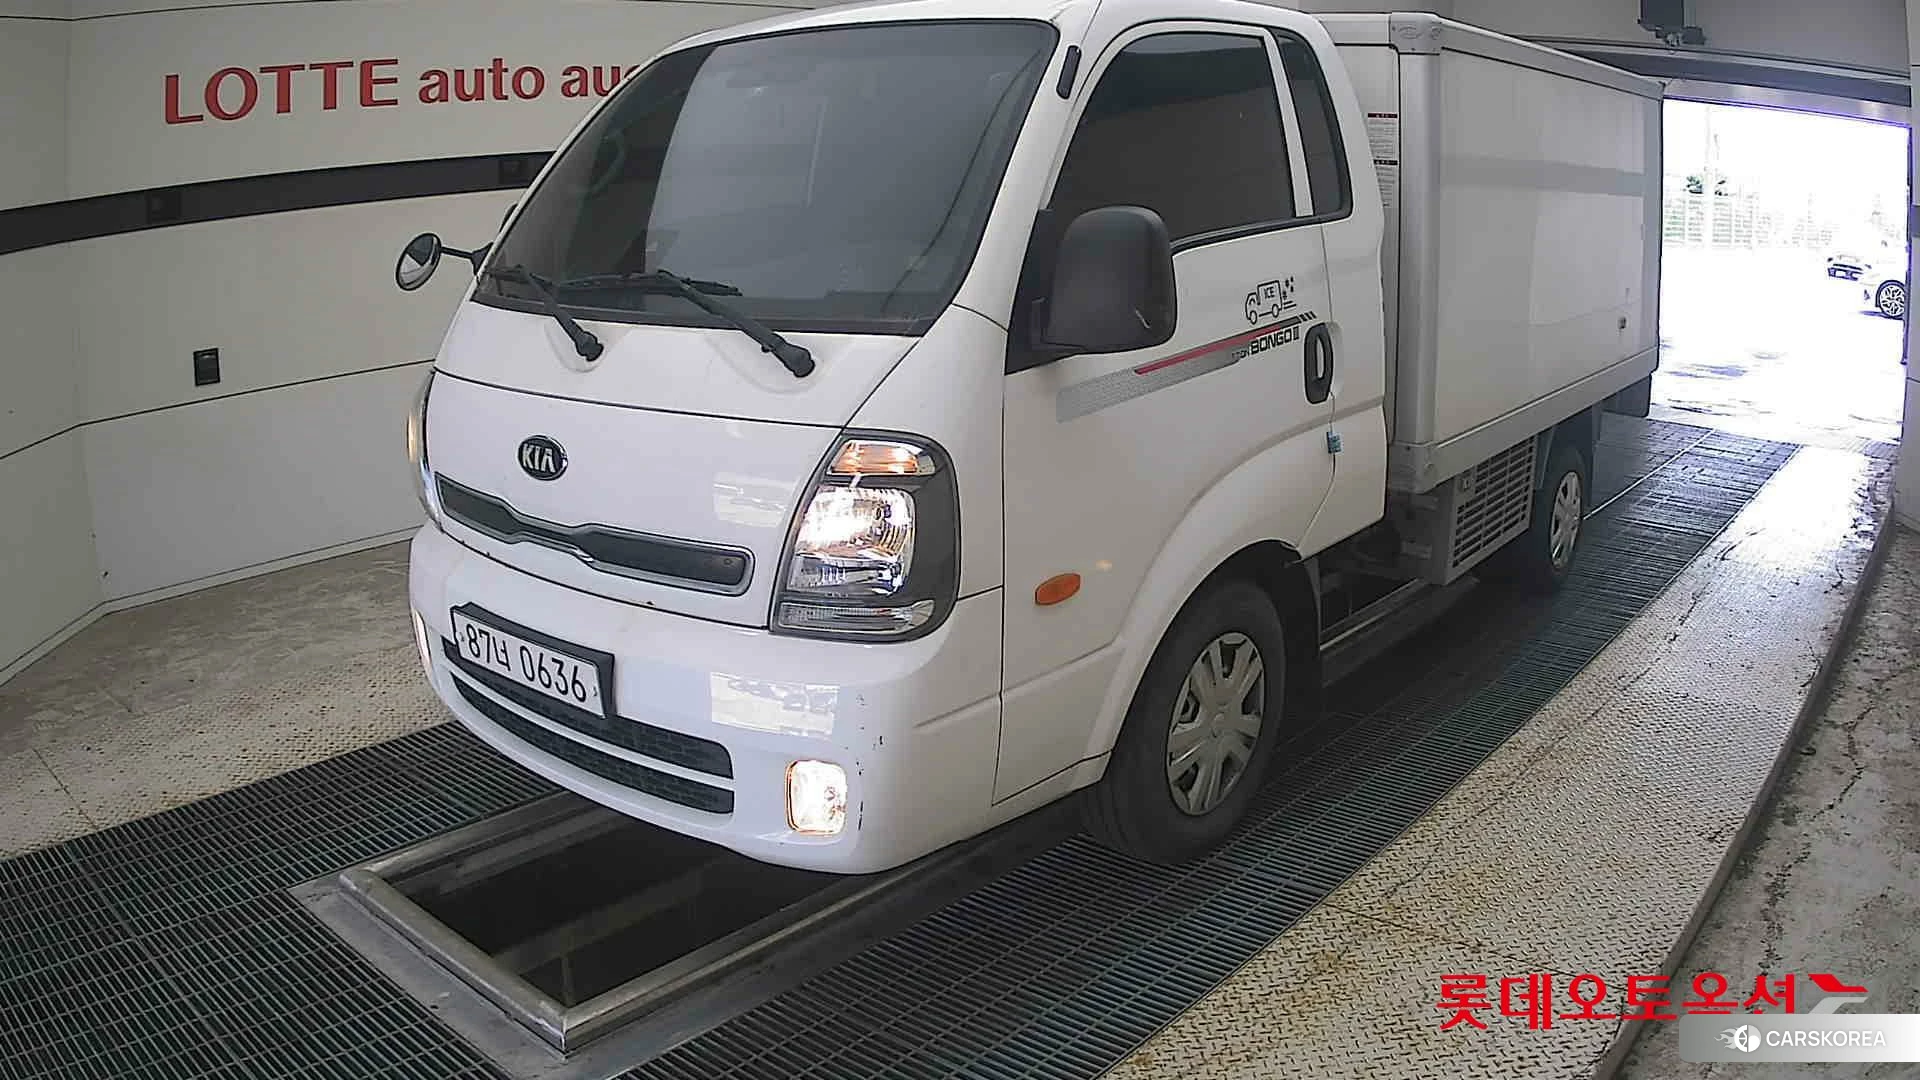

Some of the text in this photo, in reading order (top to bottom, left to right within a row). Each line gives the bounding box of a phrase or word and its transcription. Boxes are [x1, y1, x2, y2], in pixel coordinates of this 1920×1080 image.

[164, 58, 399, 125] LOTTE
[418, 58, 545, 103] auto
[522, 443, 556, 473] KIA
[466, 624, 587, 702] 87너 0636
